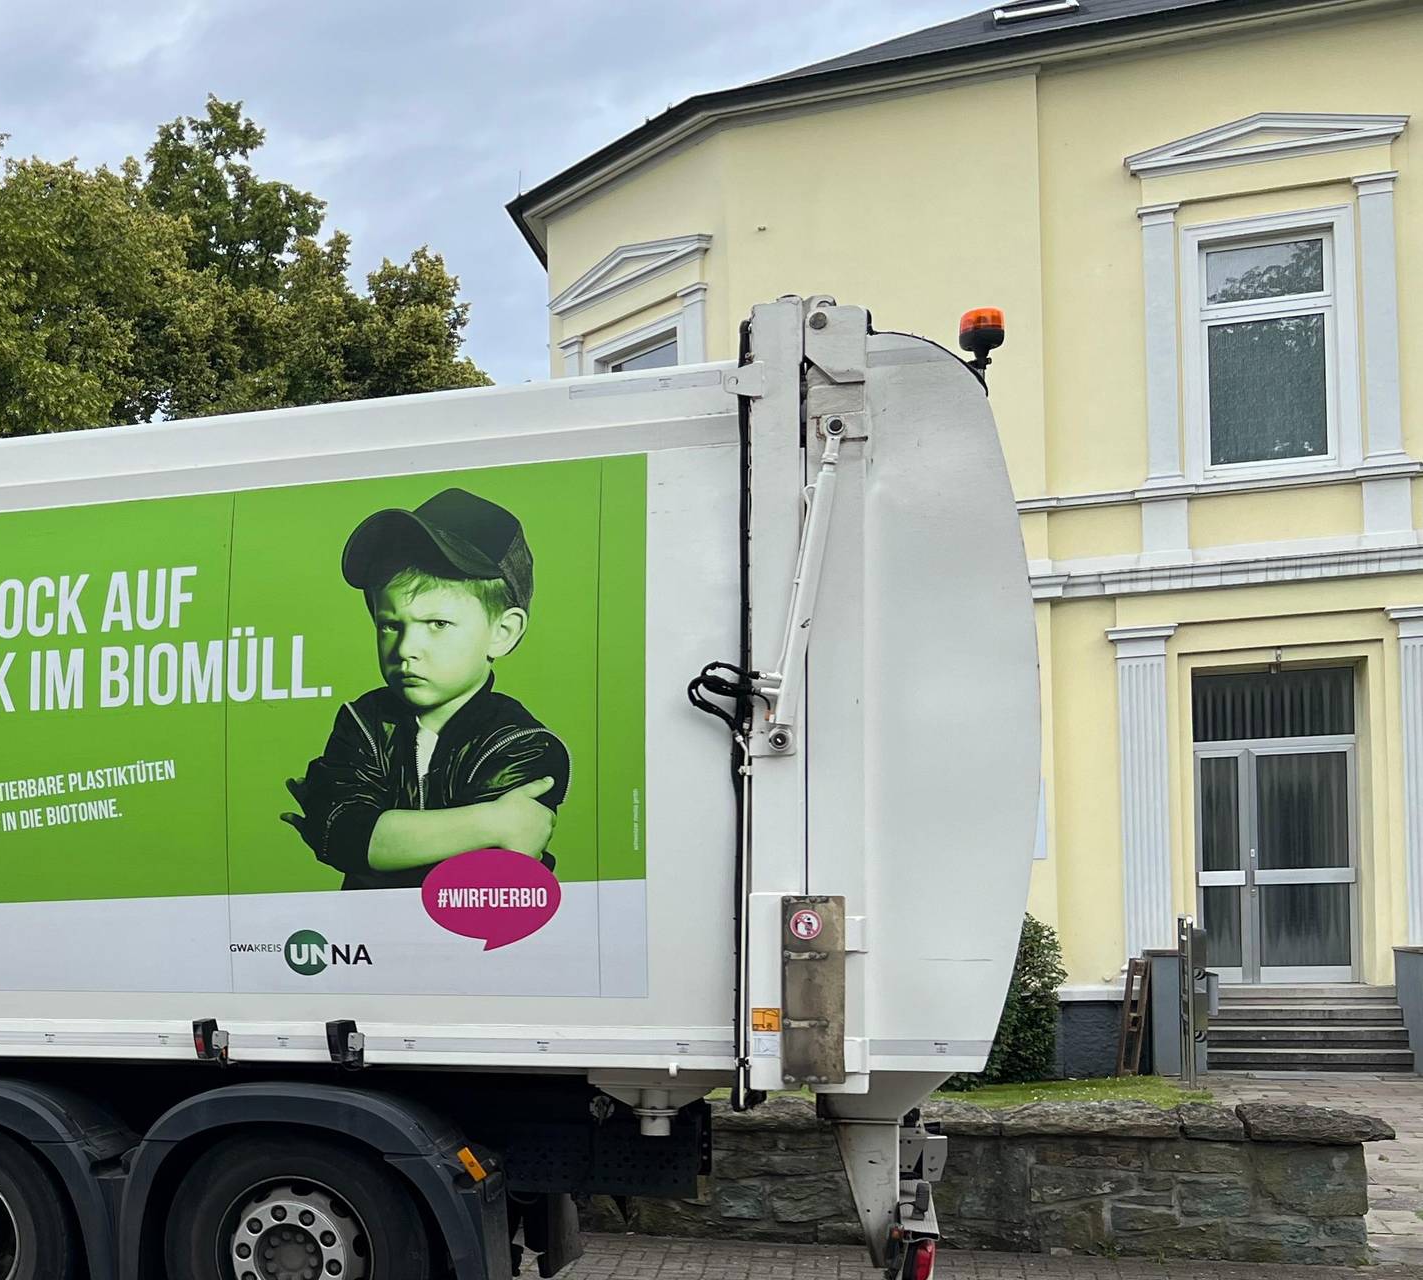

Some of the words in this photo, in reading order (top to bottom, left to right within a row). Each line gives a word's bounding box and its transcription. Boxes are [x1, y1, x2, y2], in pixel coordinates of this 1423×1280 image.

[100, 565, 198, 633] AUF
[29, 647, 85, 712] IM
[99, 626, 333, 709] BIOMÜLL.
[67, 759, 176, 791] PLASTIKTÜTEN
[2, 811, 17, 832] IN
[19, 807, 44, 829] DIE
[46, 798, 123, 826] BIOTONNE.
[436, 887, 548, 908] #WIRFUERBIO
[289, 943, 373, 966] UNNA
